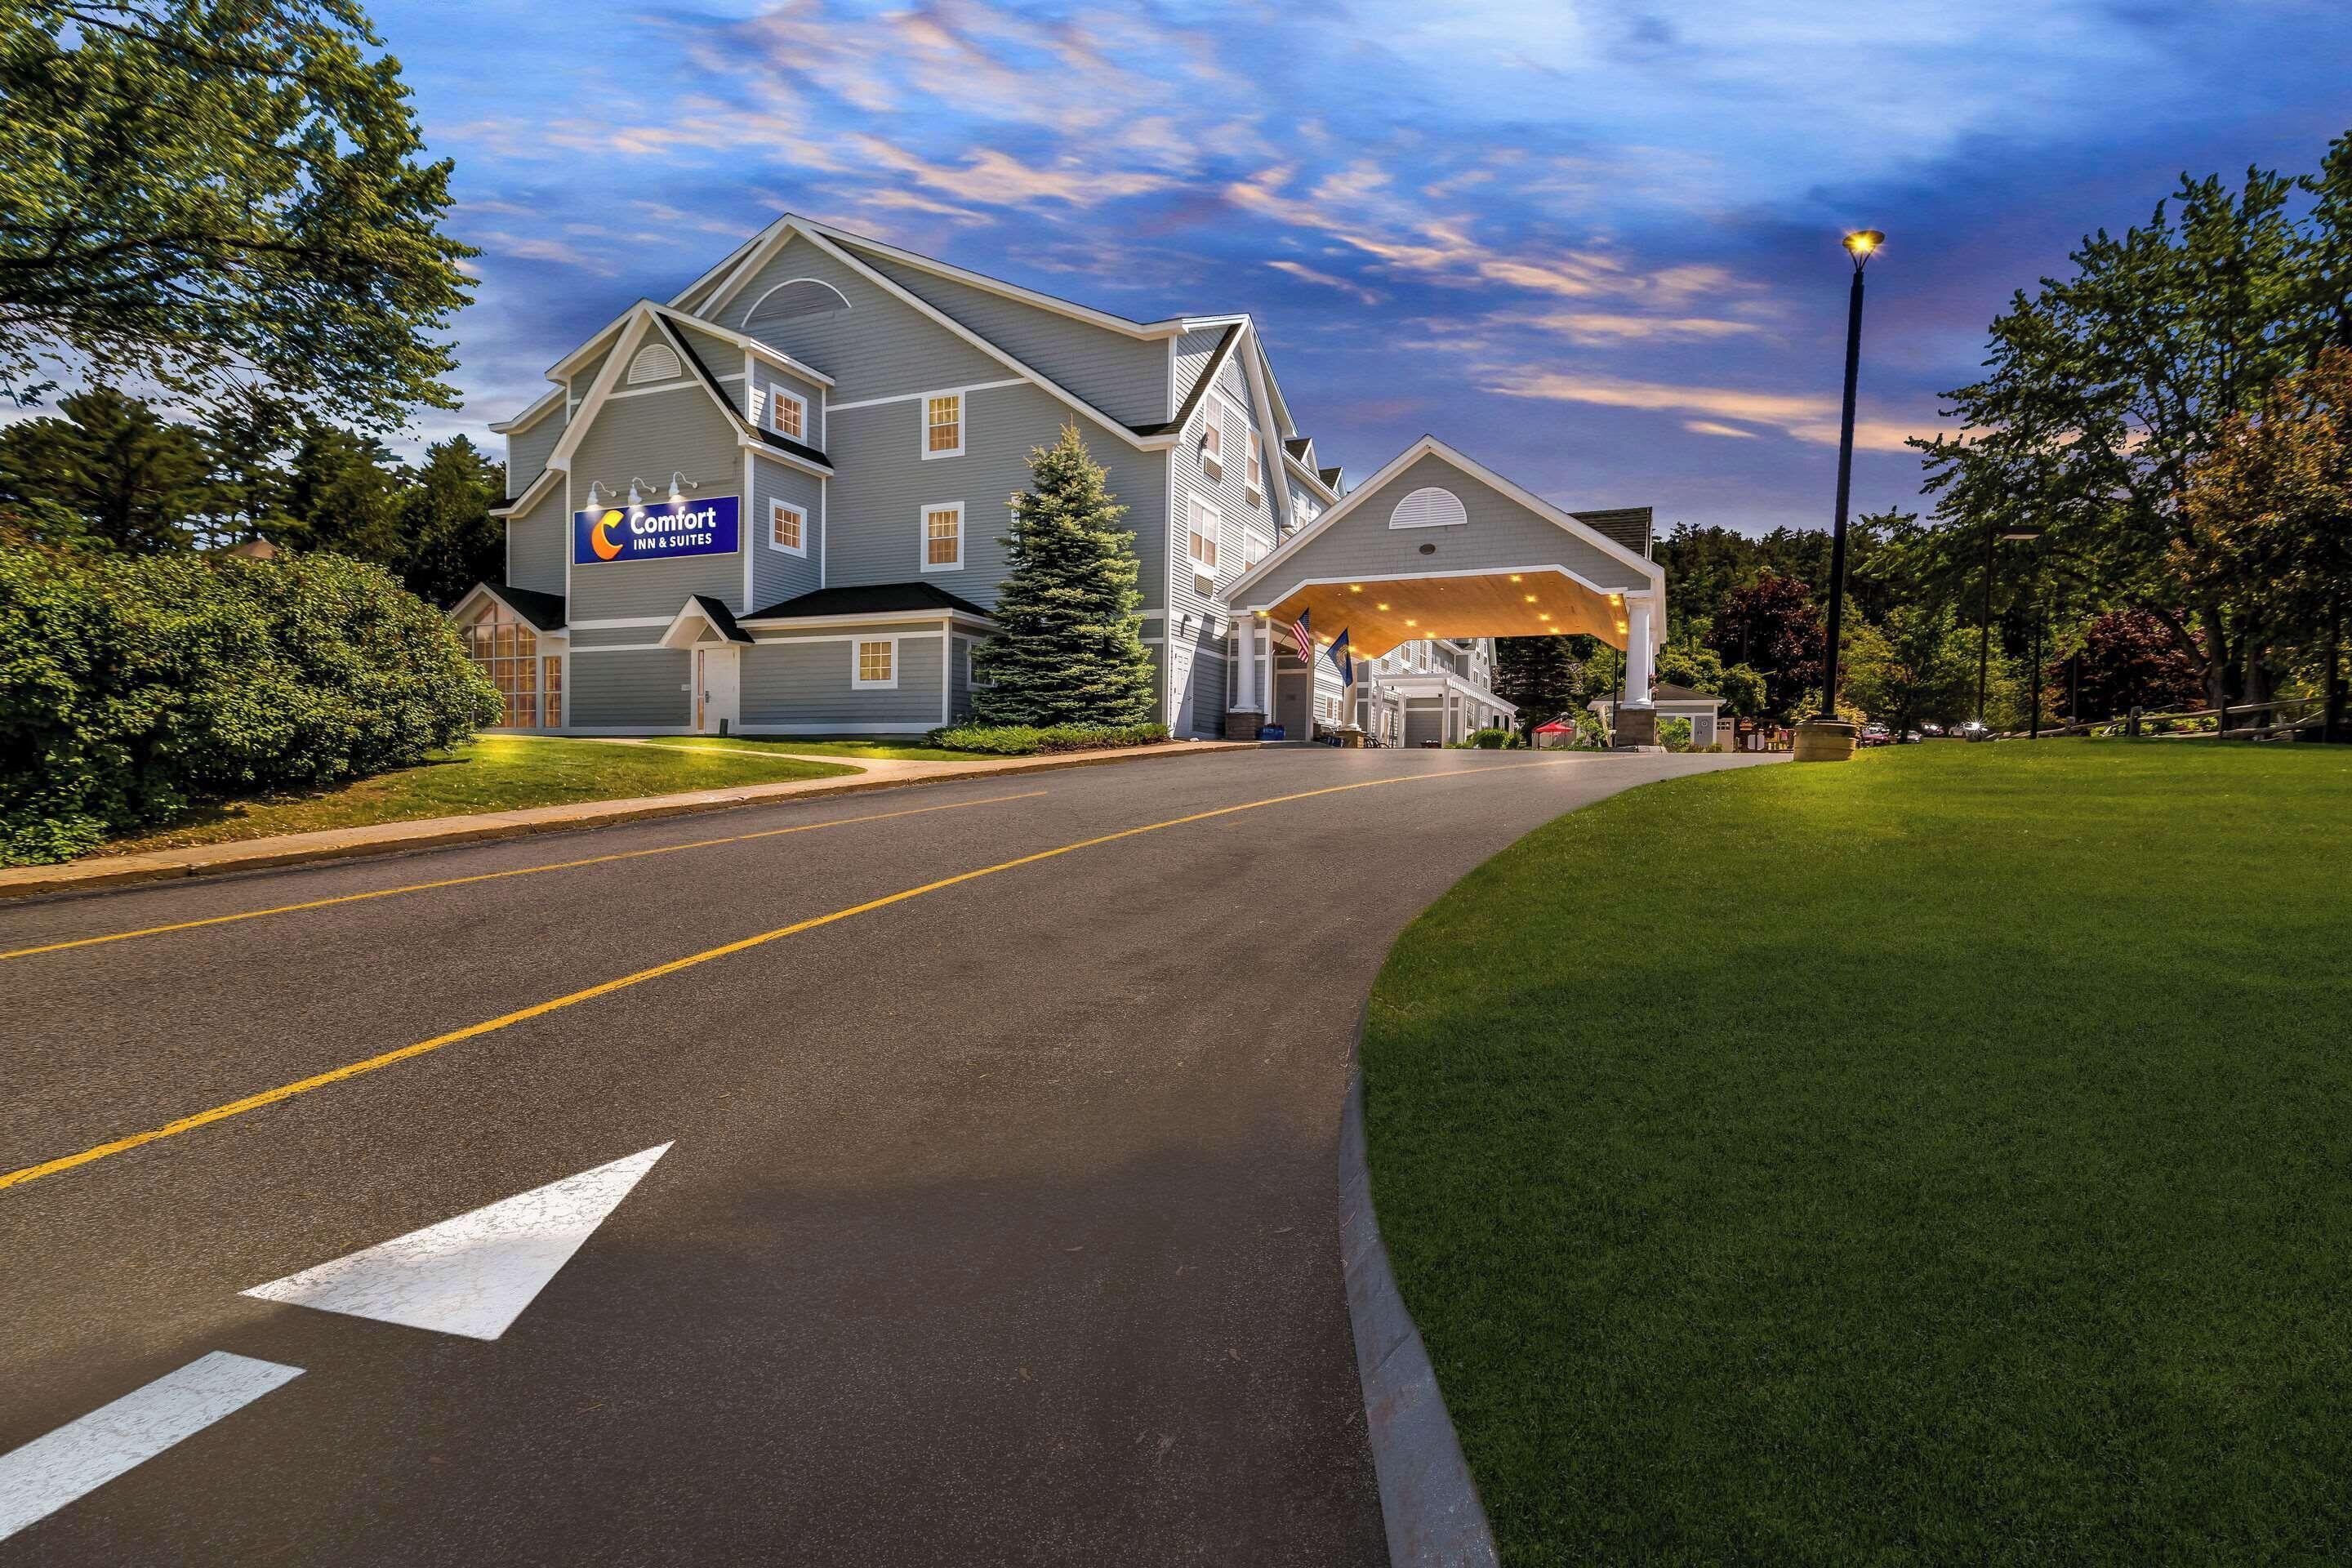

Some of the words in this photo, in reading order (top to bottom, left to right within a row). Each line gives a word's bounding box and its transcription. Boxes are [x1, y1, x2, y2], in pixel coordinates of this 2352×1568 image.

[630, 506, 717, 535] Comfort
[633, 537, 656, 550] INN
[658, 537, 667, 548] &
[669, 532, 713, 547] SUITES
